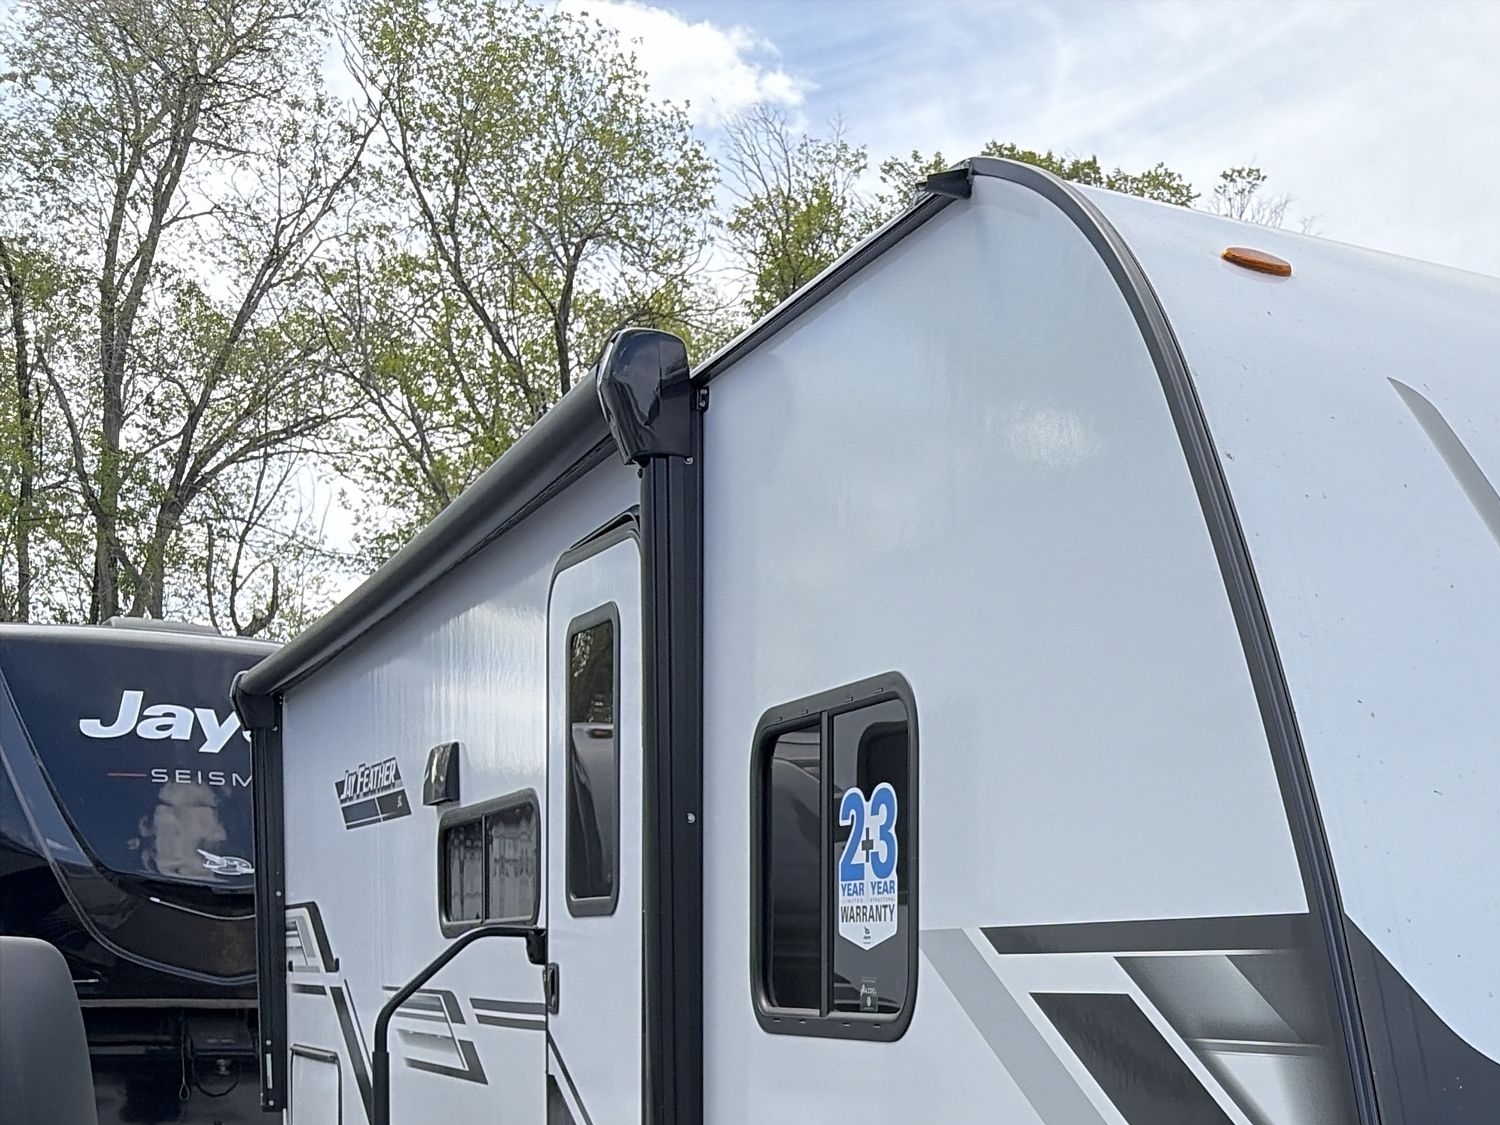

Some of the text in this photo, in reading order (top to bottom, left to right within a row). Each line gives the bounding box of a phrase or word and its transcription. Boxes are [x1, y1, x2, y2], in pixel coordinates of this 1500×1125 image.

[79, 690, 252, 753] Jay
[340, 759, 397, 800] JAY FEATHER
[841, 880, 895, 897] YEAR YEAR
[841, 904, 895, 923] WARRANTY
